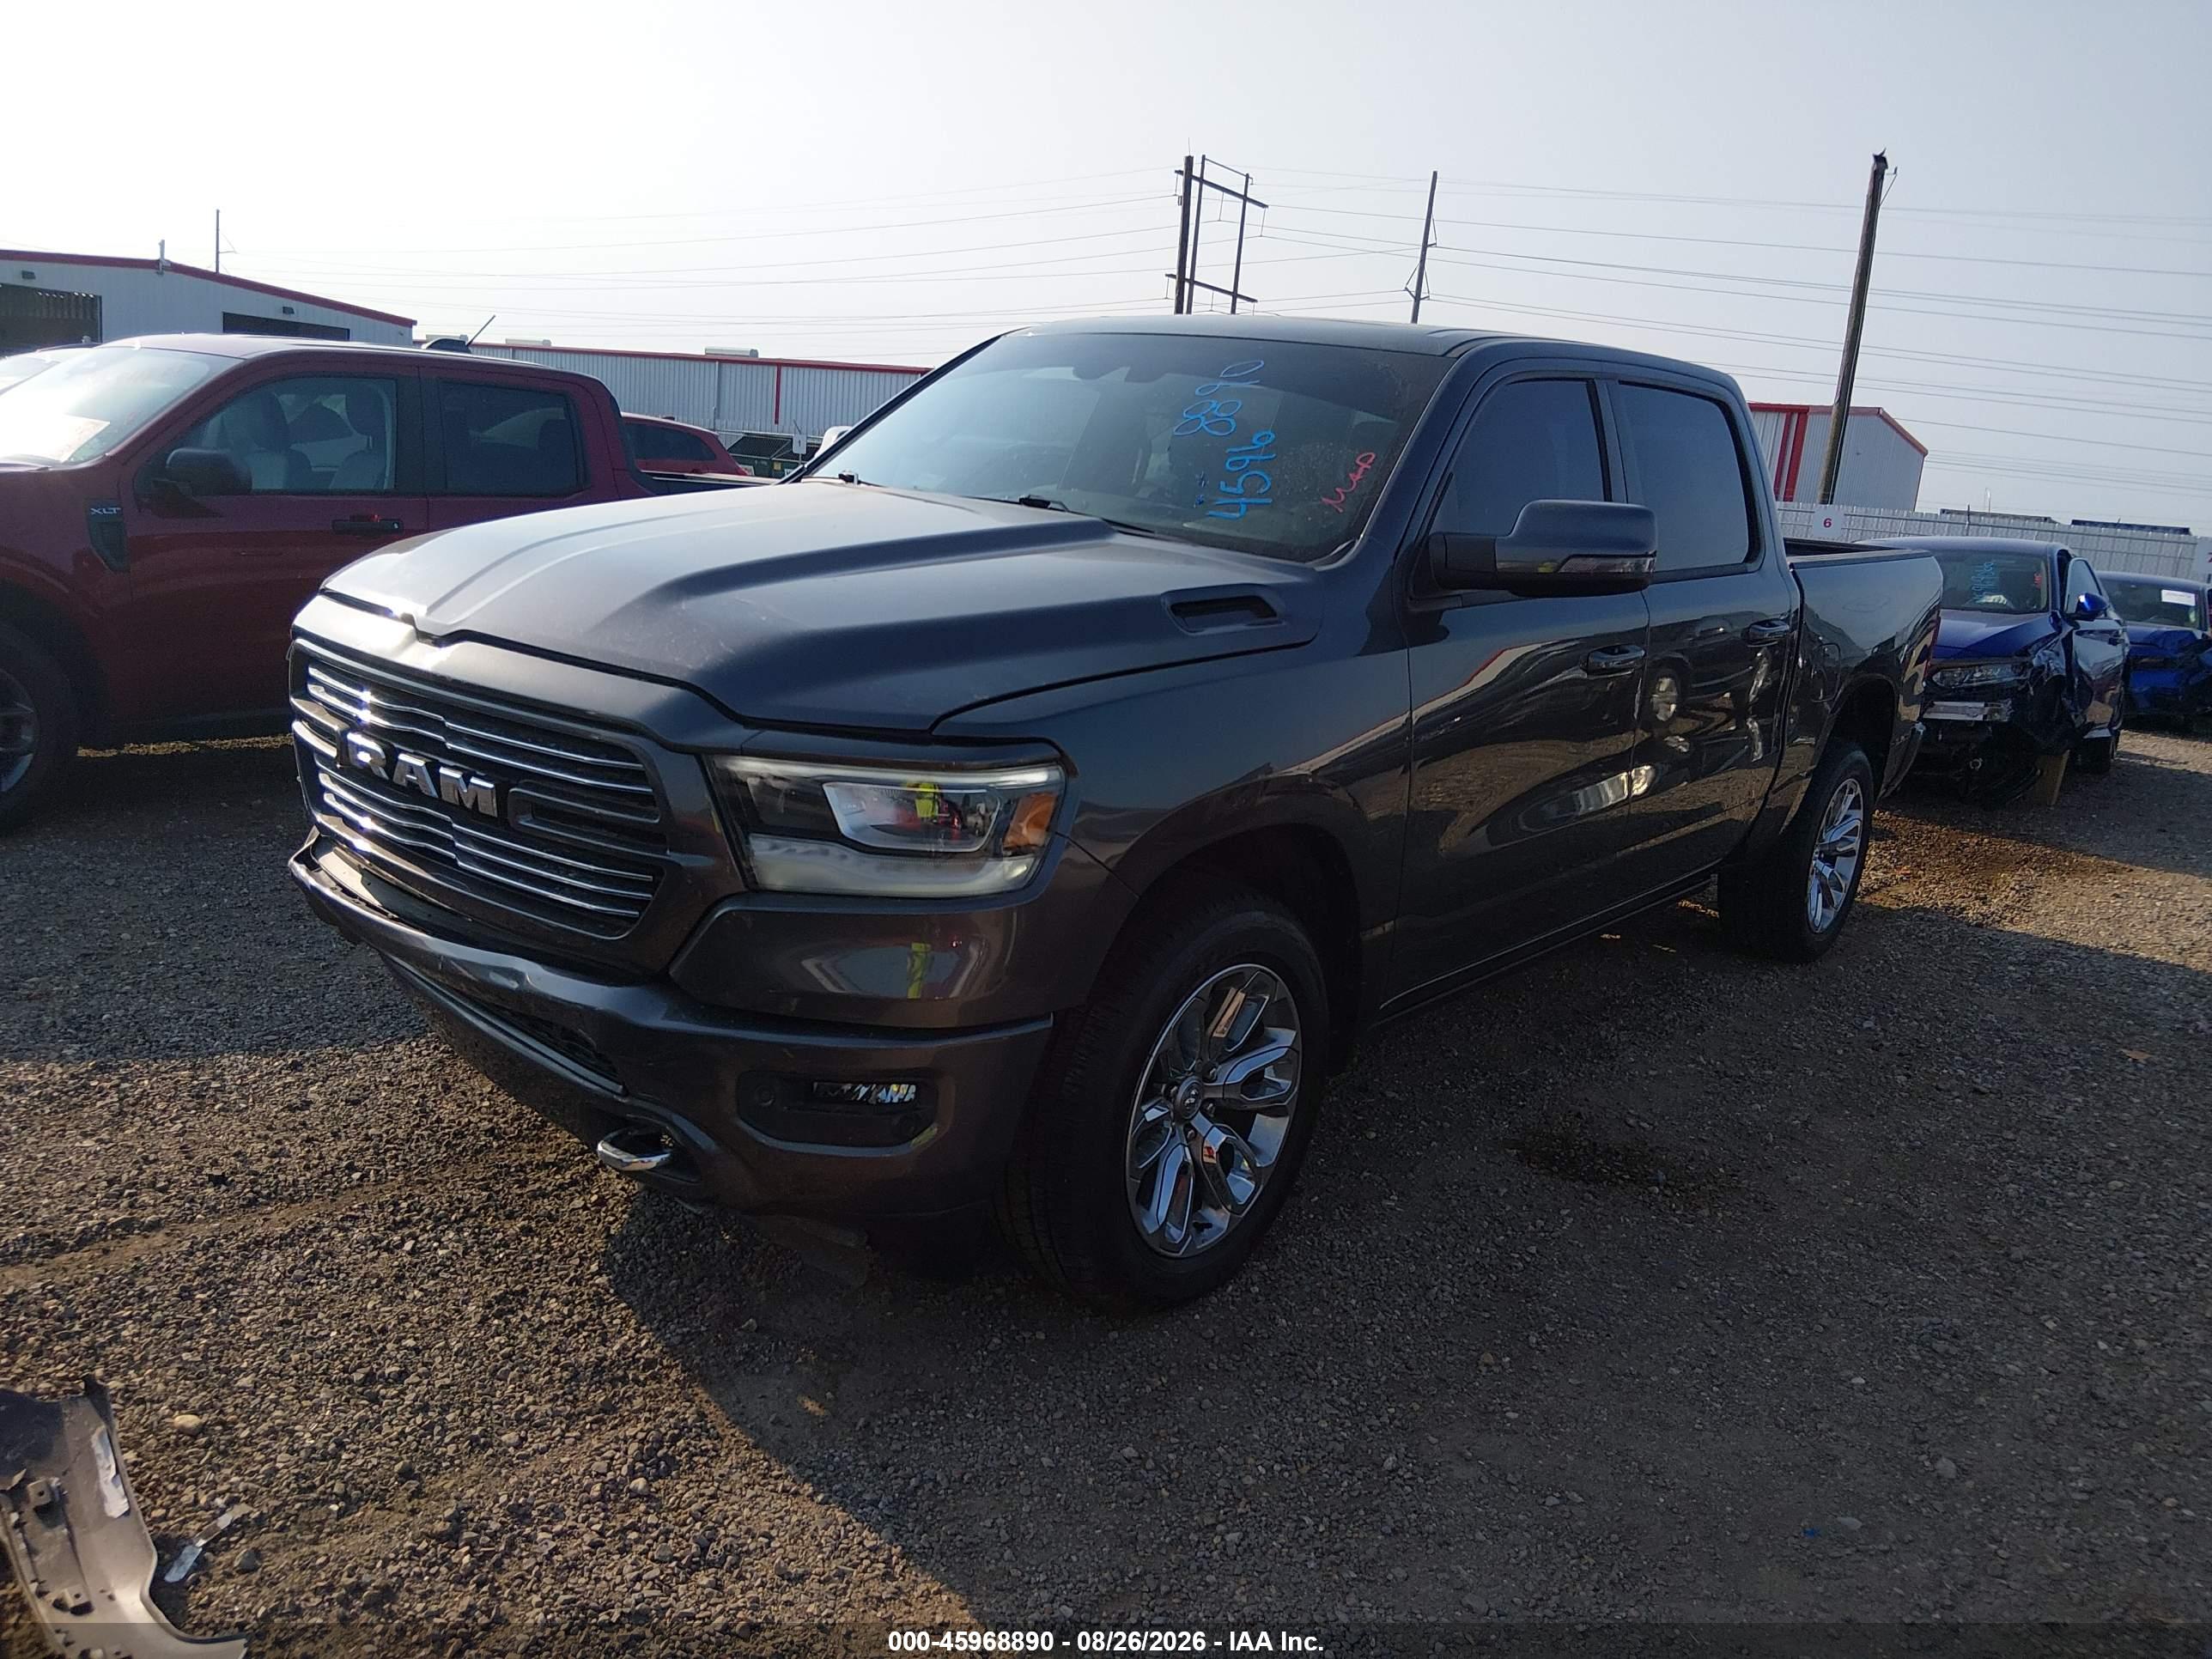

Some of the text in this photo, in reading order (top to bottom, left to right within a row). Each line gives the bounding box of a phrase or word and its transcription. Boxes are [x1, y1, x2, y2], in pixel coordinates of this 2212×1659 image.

[1206, 430, 1277, 520] 4596
[89, 507, 122, 515] XLT
[1823, 517, 1832, 528] 6
[346, 732, 498, 817] RAM
